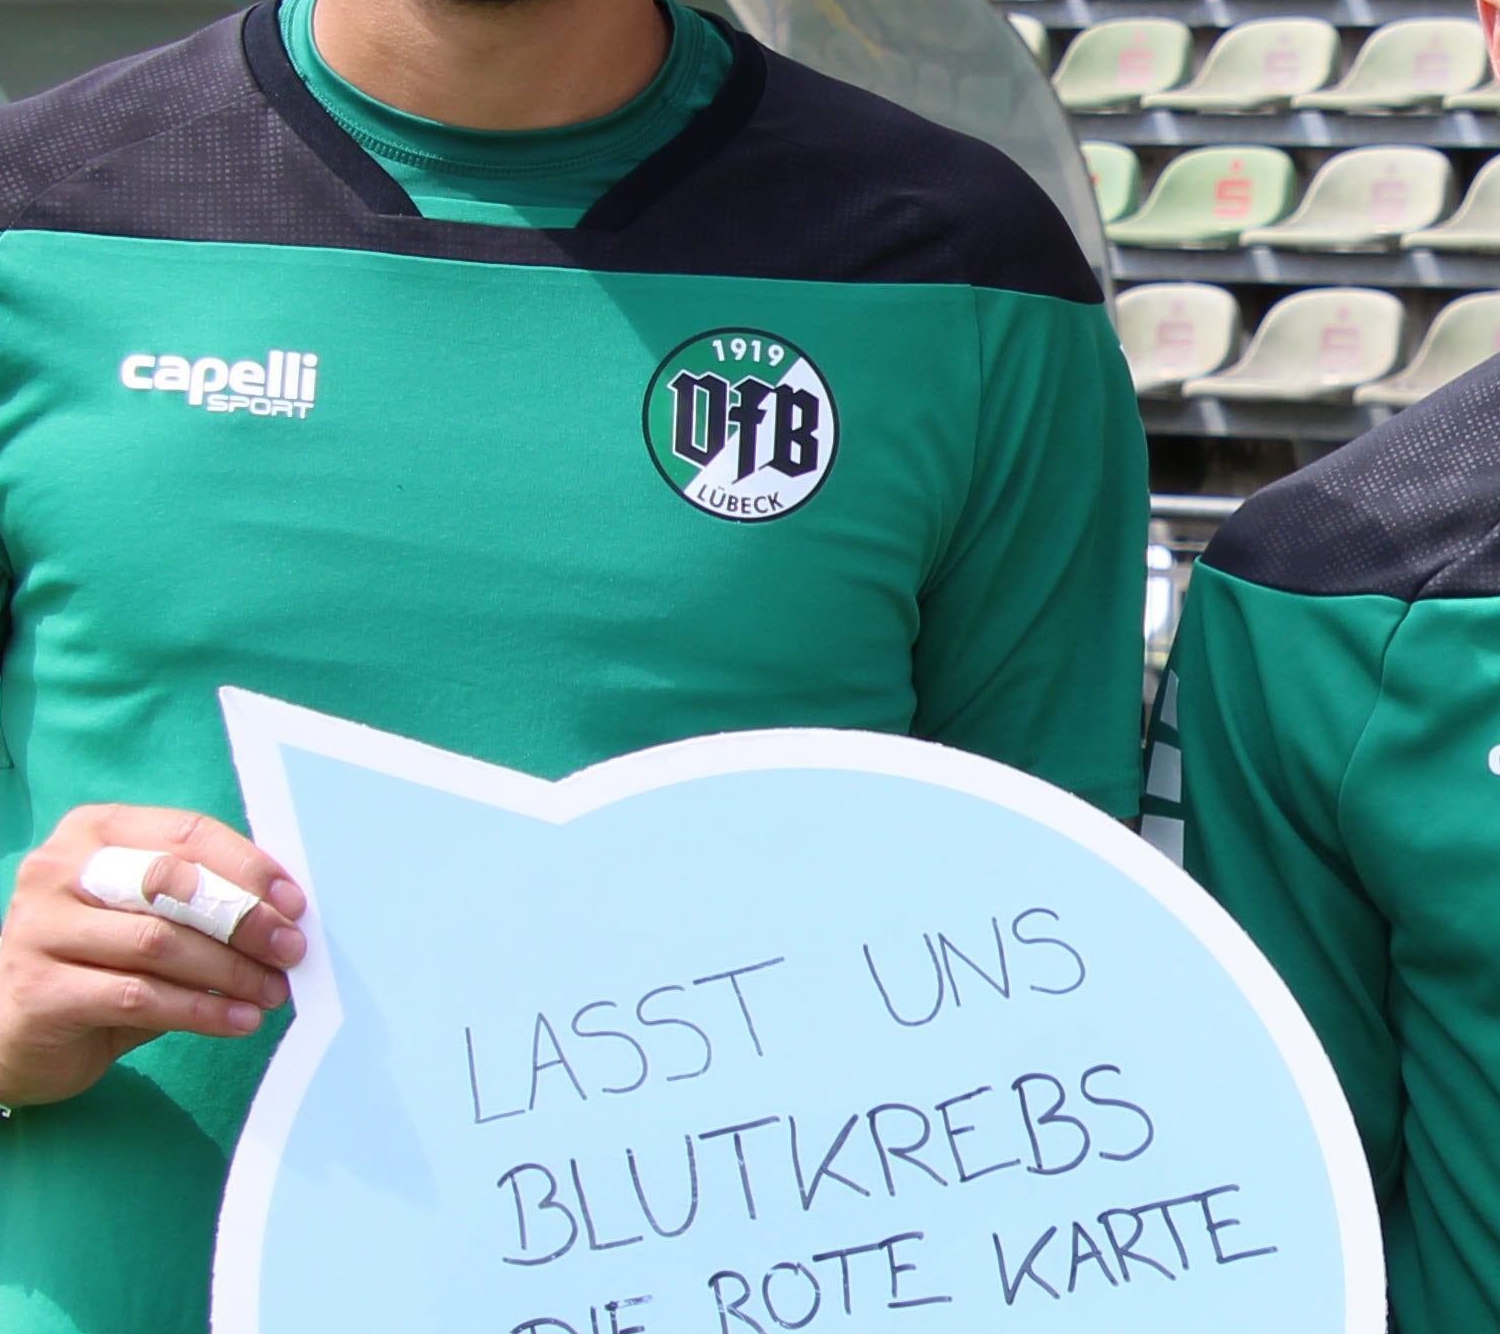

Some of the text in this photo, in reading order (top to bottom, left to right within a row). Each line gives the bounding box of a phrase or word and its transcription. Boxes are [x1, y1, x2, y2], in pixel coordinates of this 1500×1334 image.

[120, 349, 318, 405] capelli
[712, 338, 785, 367] 1919
[206, 394, 314, 419] SPORT
[666, 369, 820, 485] VfB
[696, 484, 784, 514] LÜBECK
[464, 906, 1087, 1124] LASST UNS
[496, 1063, 1156, 1267] BLUTKREBS
[991, 1183, 1279, 1306] KARTE
